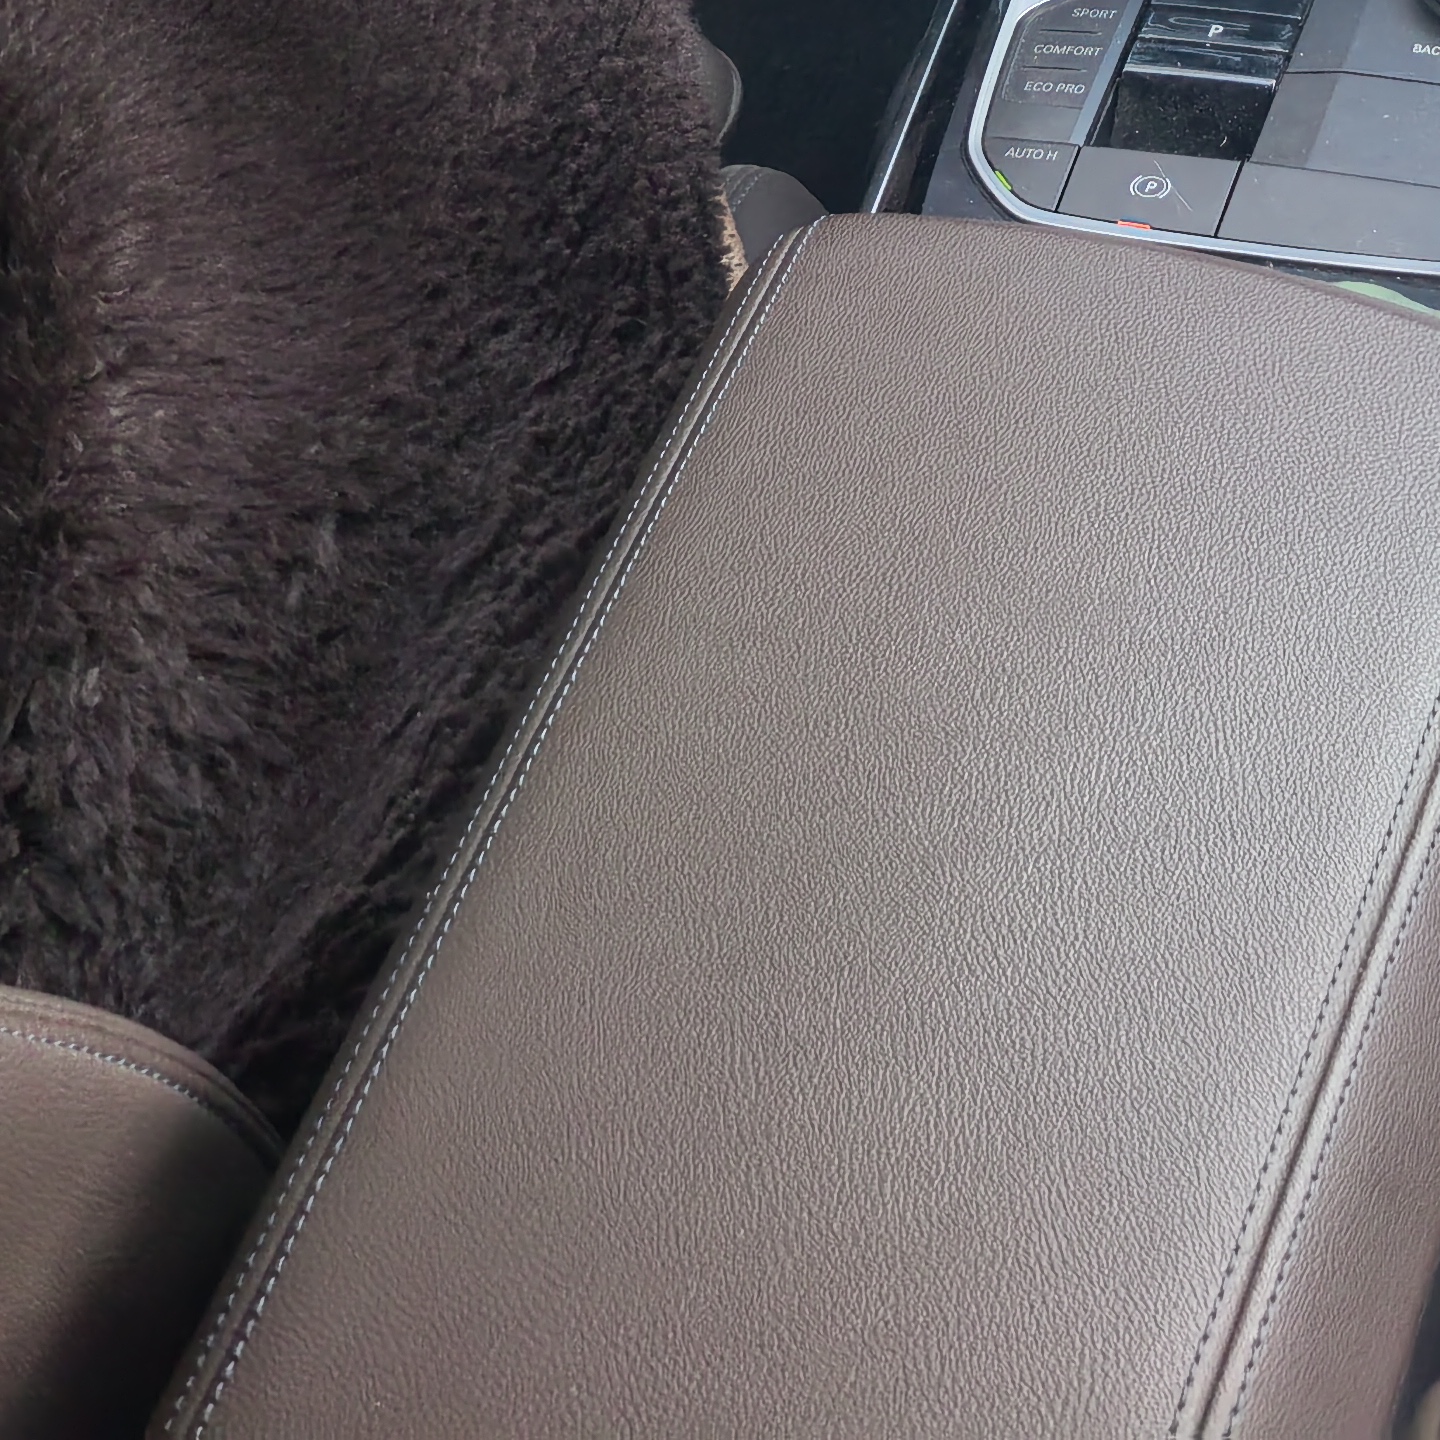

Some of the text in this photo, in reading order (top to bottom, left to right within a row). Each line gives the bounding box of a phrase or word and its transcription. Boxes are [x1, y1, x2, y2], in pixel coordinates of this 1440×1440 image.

[1071, 7, 1118, 20] SPORT
[1207, 24, 1224, 38] P
[1033, 43, 1104, 57] COMFORT
[1023, 80, 1086, 95] ECO PRO
[1004, 145, 1059, 161] AUTO H
